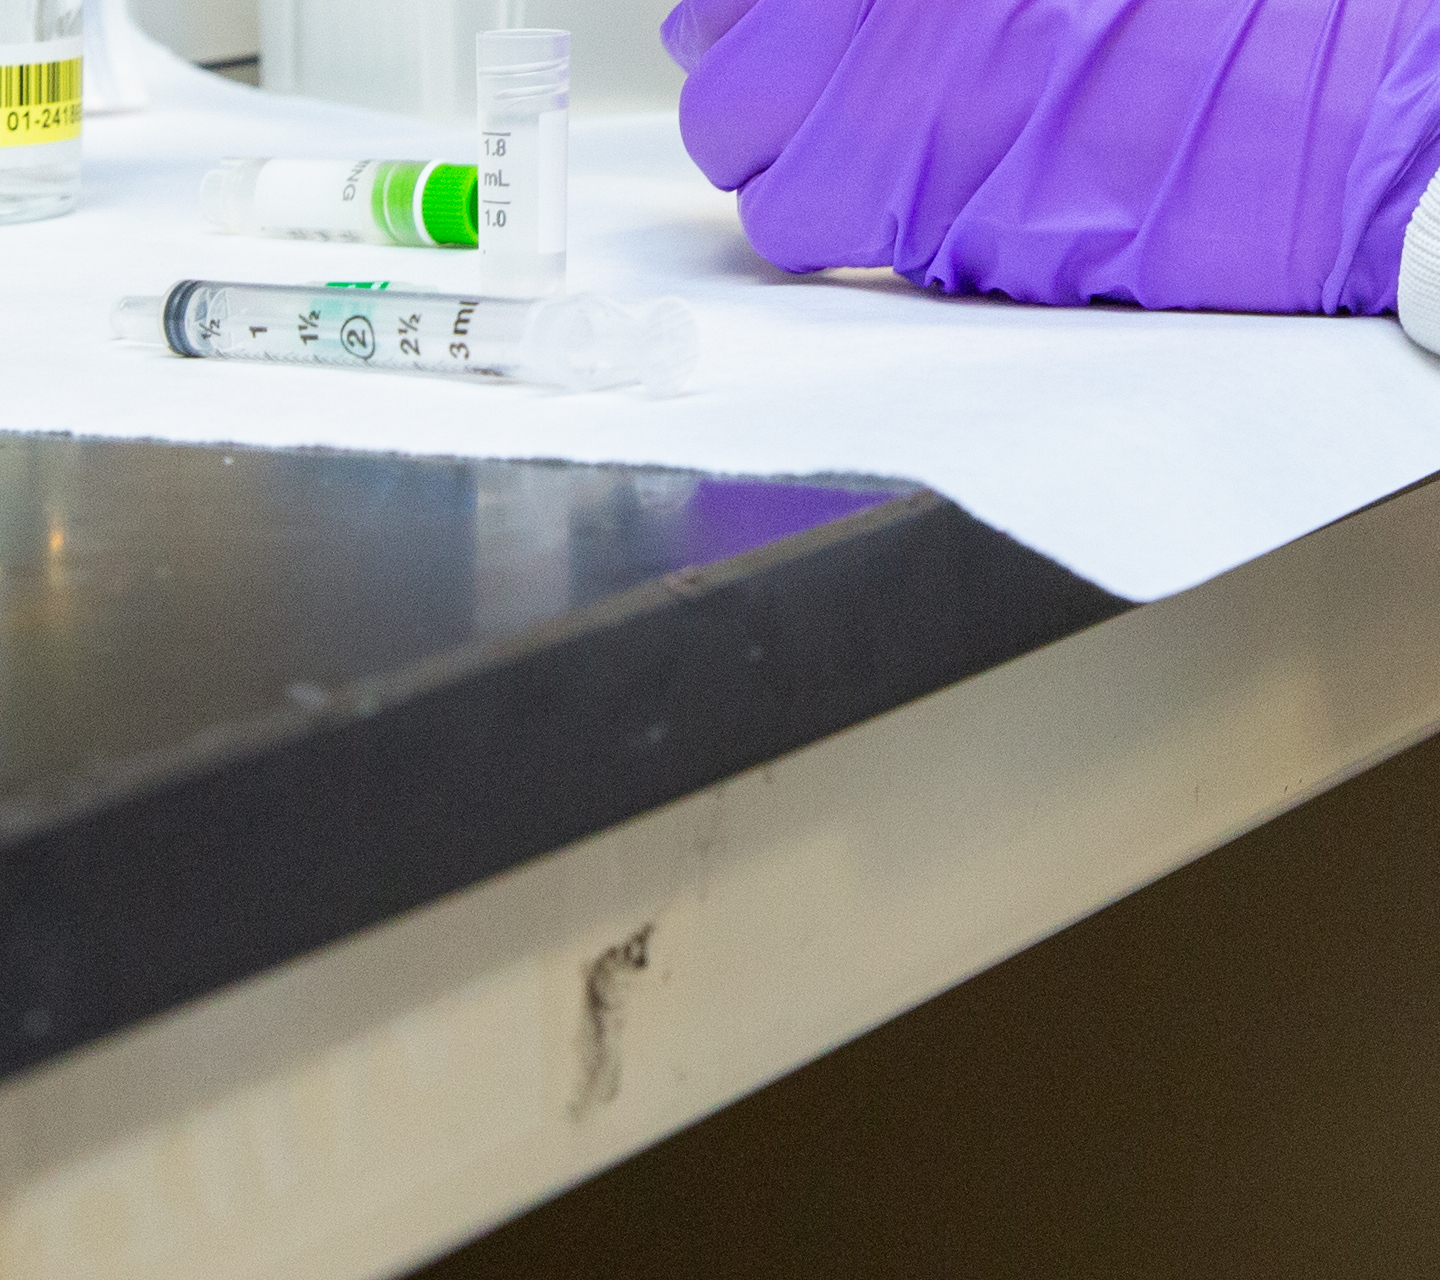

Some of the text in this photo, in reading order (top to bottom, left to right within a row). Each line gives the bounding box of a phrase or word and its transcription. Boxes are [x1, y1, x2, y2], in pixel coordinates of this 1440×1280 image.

[484, 138, 507, 157] 1.8
[484, 170, 510, 187] mL
[484, 209, 507, 228] 1.0
[249, 325, 268, 338] 1
[449, 341, 471, 360] 3
